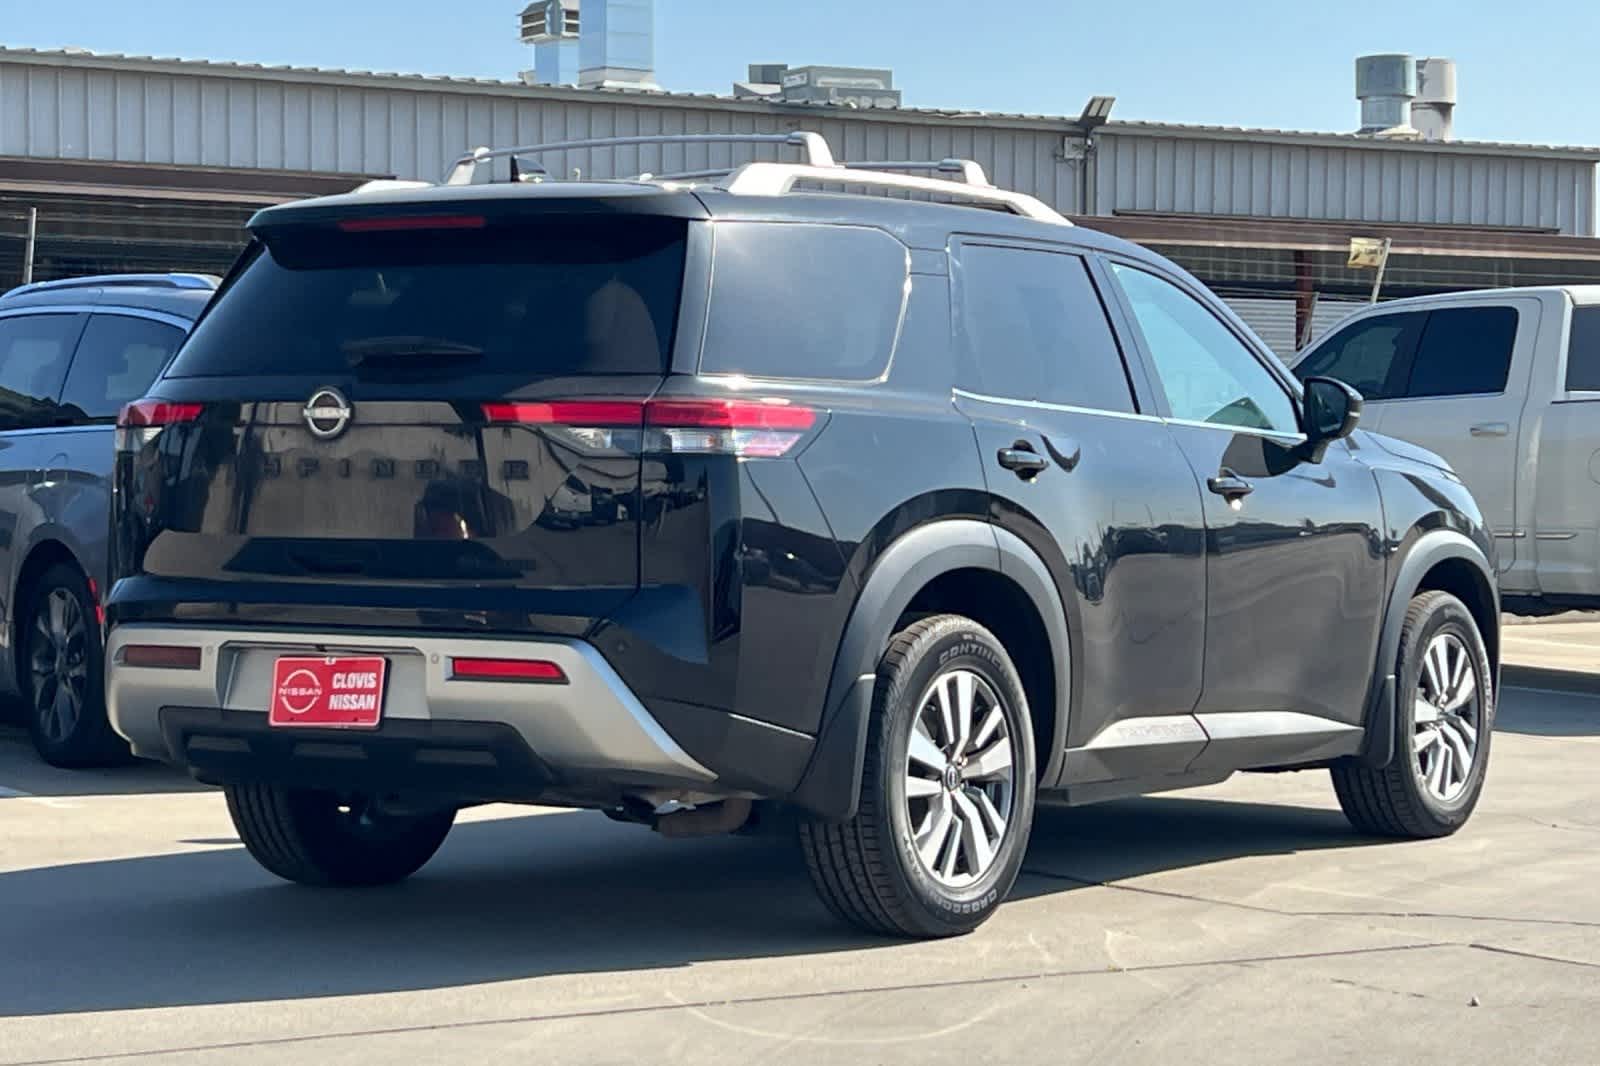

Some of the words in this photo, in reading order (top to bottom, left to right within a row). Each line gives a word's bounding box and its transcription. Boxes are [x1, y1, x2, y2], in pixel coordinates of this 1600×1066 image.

[264, 457, 529, 480] HFINDER
[332, 672, 377, 689] CLOVIS
[279, 687, 322, 696] NISSAN
[328, 694, 376, 710] NISSAN
